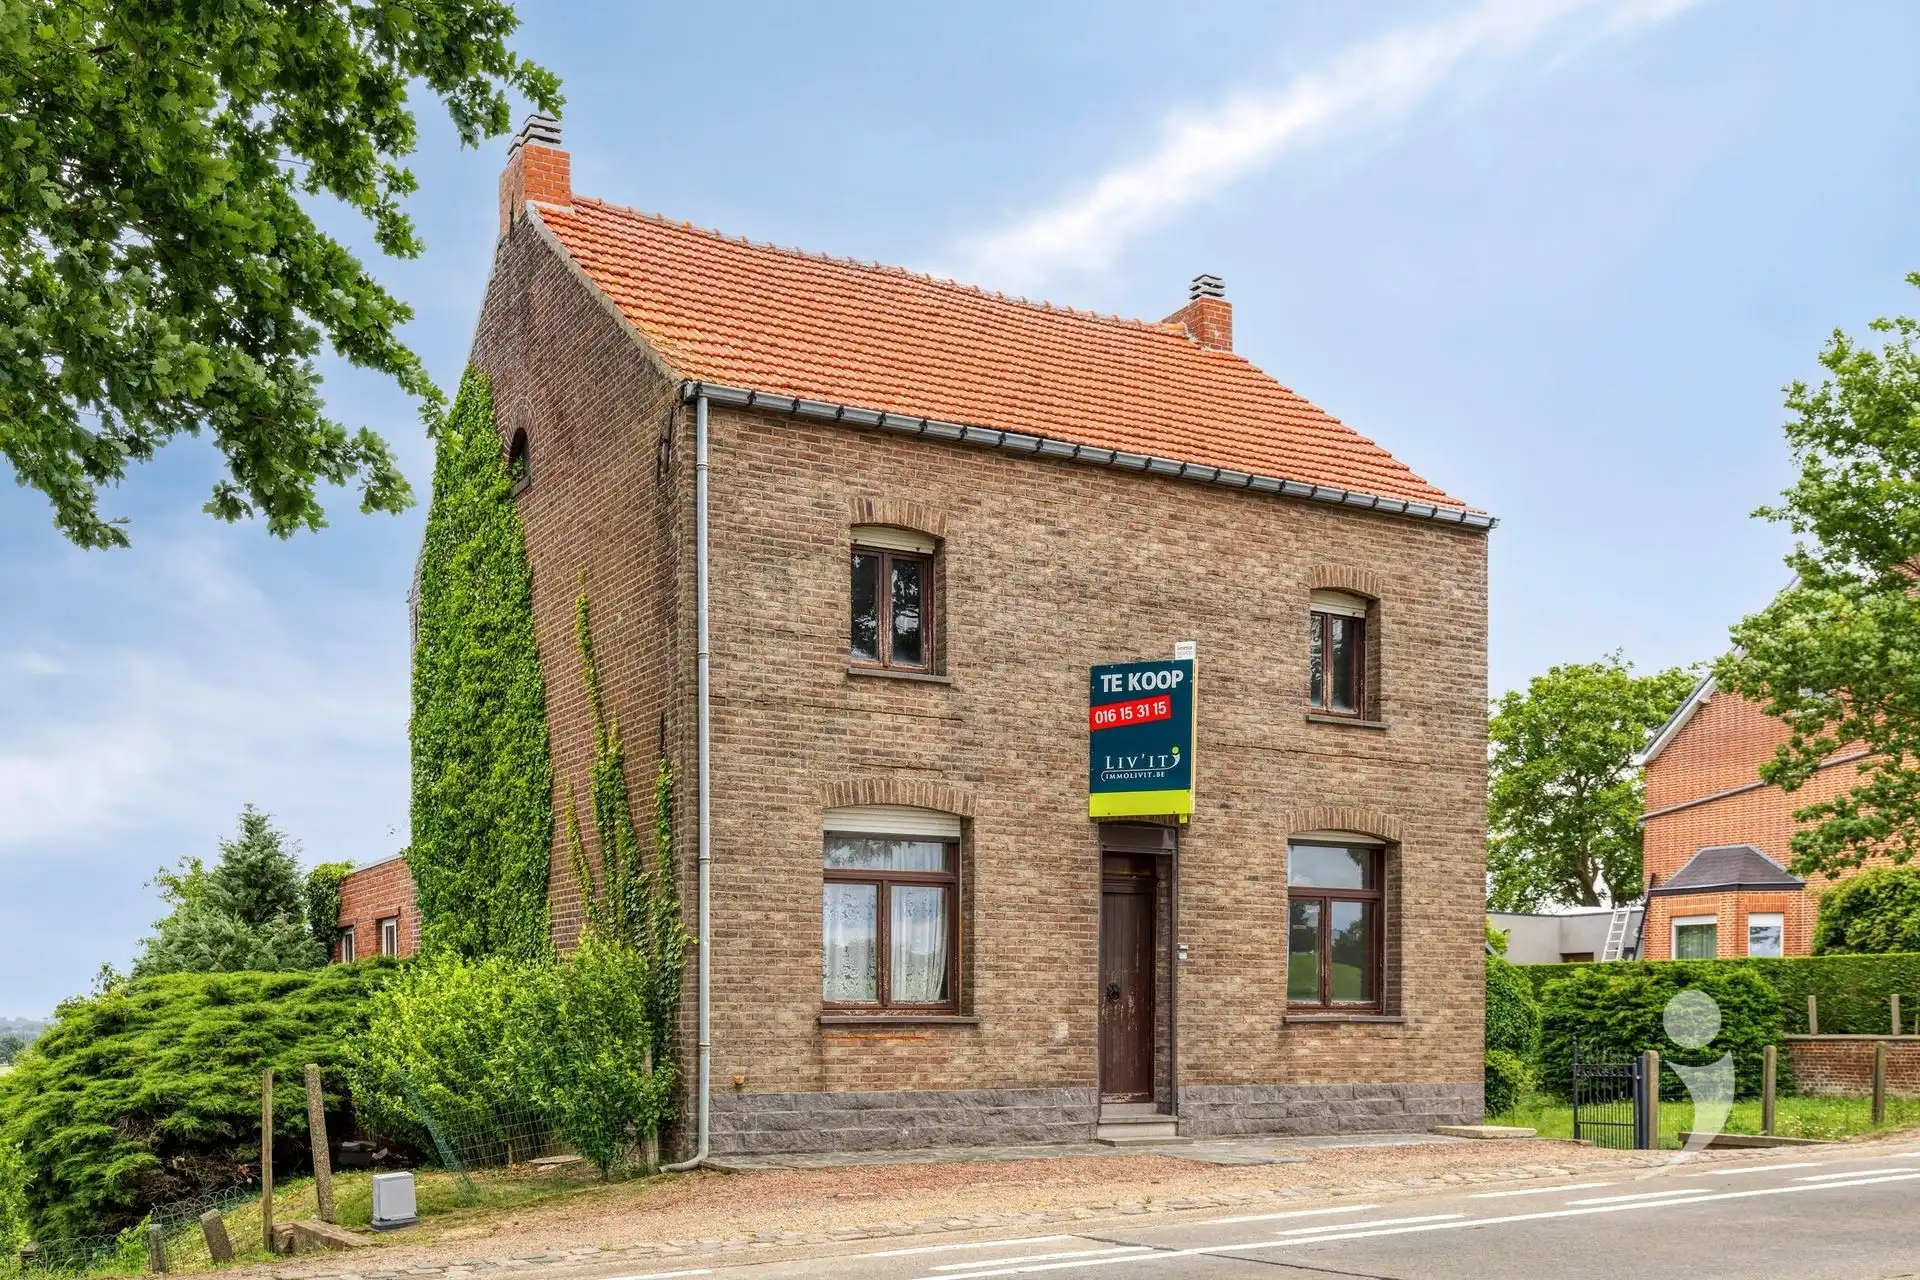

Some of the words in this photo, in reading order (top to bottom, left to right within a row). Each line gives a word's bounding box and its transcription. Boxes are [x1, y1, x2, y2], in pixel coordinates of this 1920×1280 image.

[1100, 673, 1123, 693] TE
[1128, 669, 1184, 691] KOOP
[1095, 708, 1117, 725] 016
[1119, 705, 1133, 721] 15
[1136, 703, 1150, 718] 31
[1152, 701, 1167, 716] 15
[1105, 771, 1165, 780] IMMOLIVIT.BE
